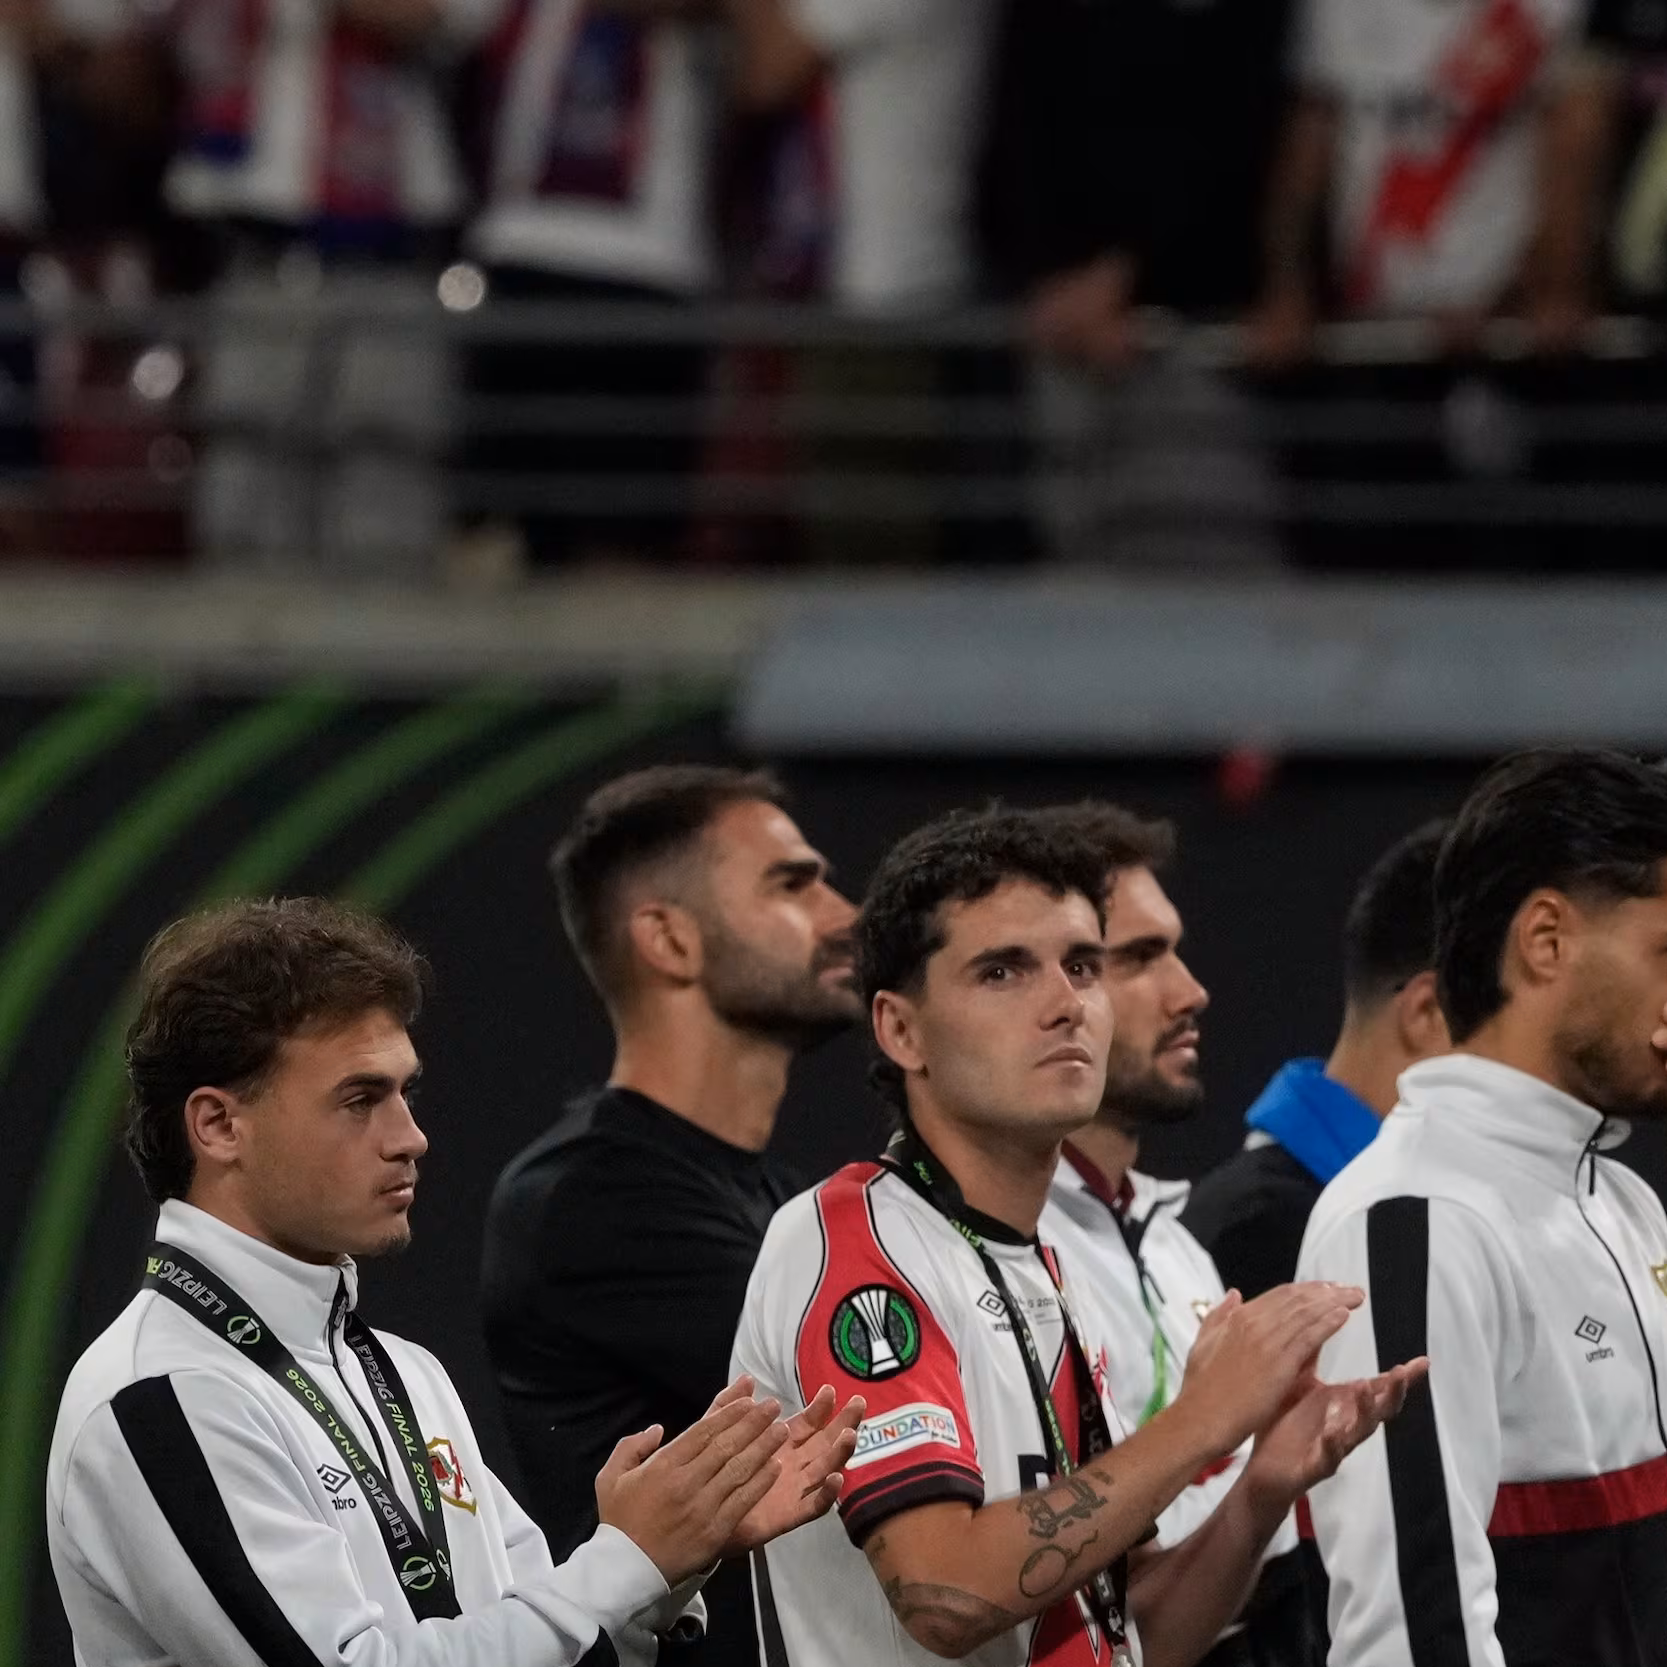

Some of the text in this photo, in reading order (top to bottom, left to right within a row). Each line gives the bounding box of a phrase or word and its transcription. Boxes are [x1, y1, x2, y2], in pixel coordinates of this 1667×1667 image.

[157, 1260, 228, 1316] LEIPZIG
[285, 1368, 412, 1550] LEIPZIG FINAL 2026
[347, 1335, 435, 1512] LEIPZIG FINAL 2026
[857, 1415, 955, 1448] OUNDATION
